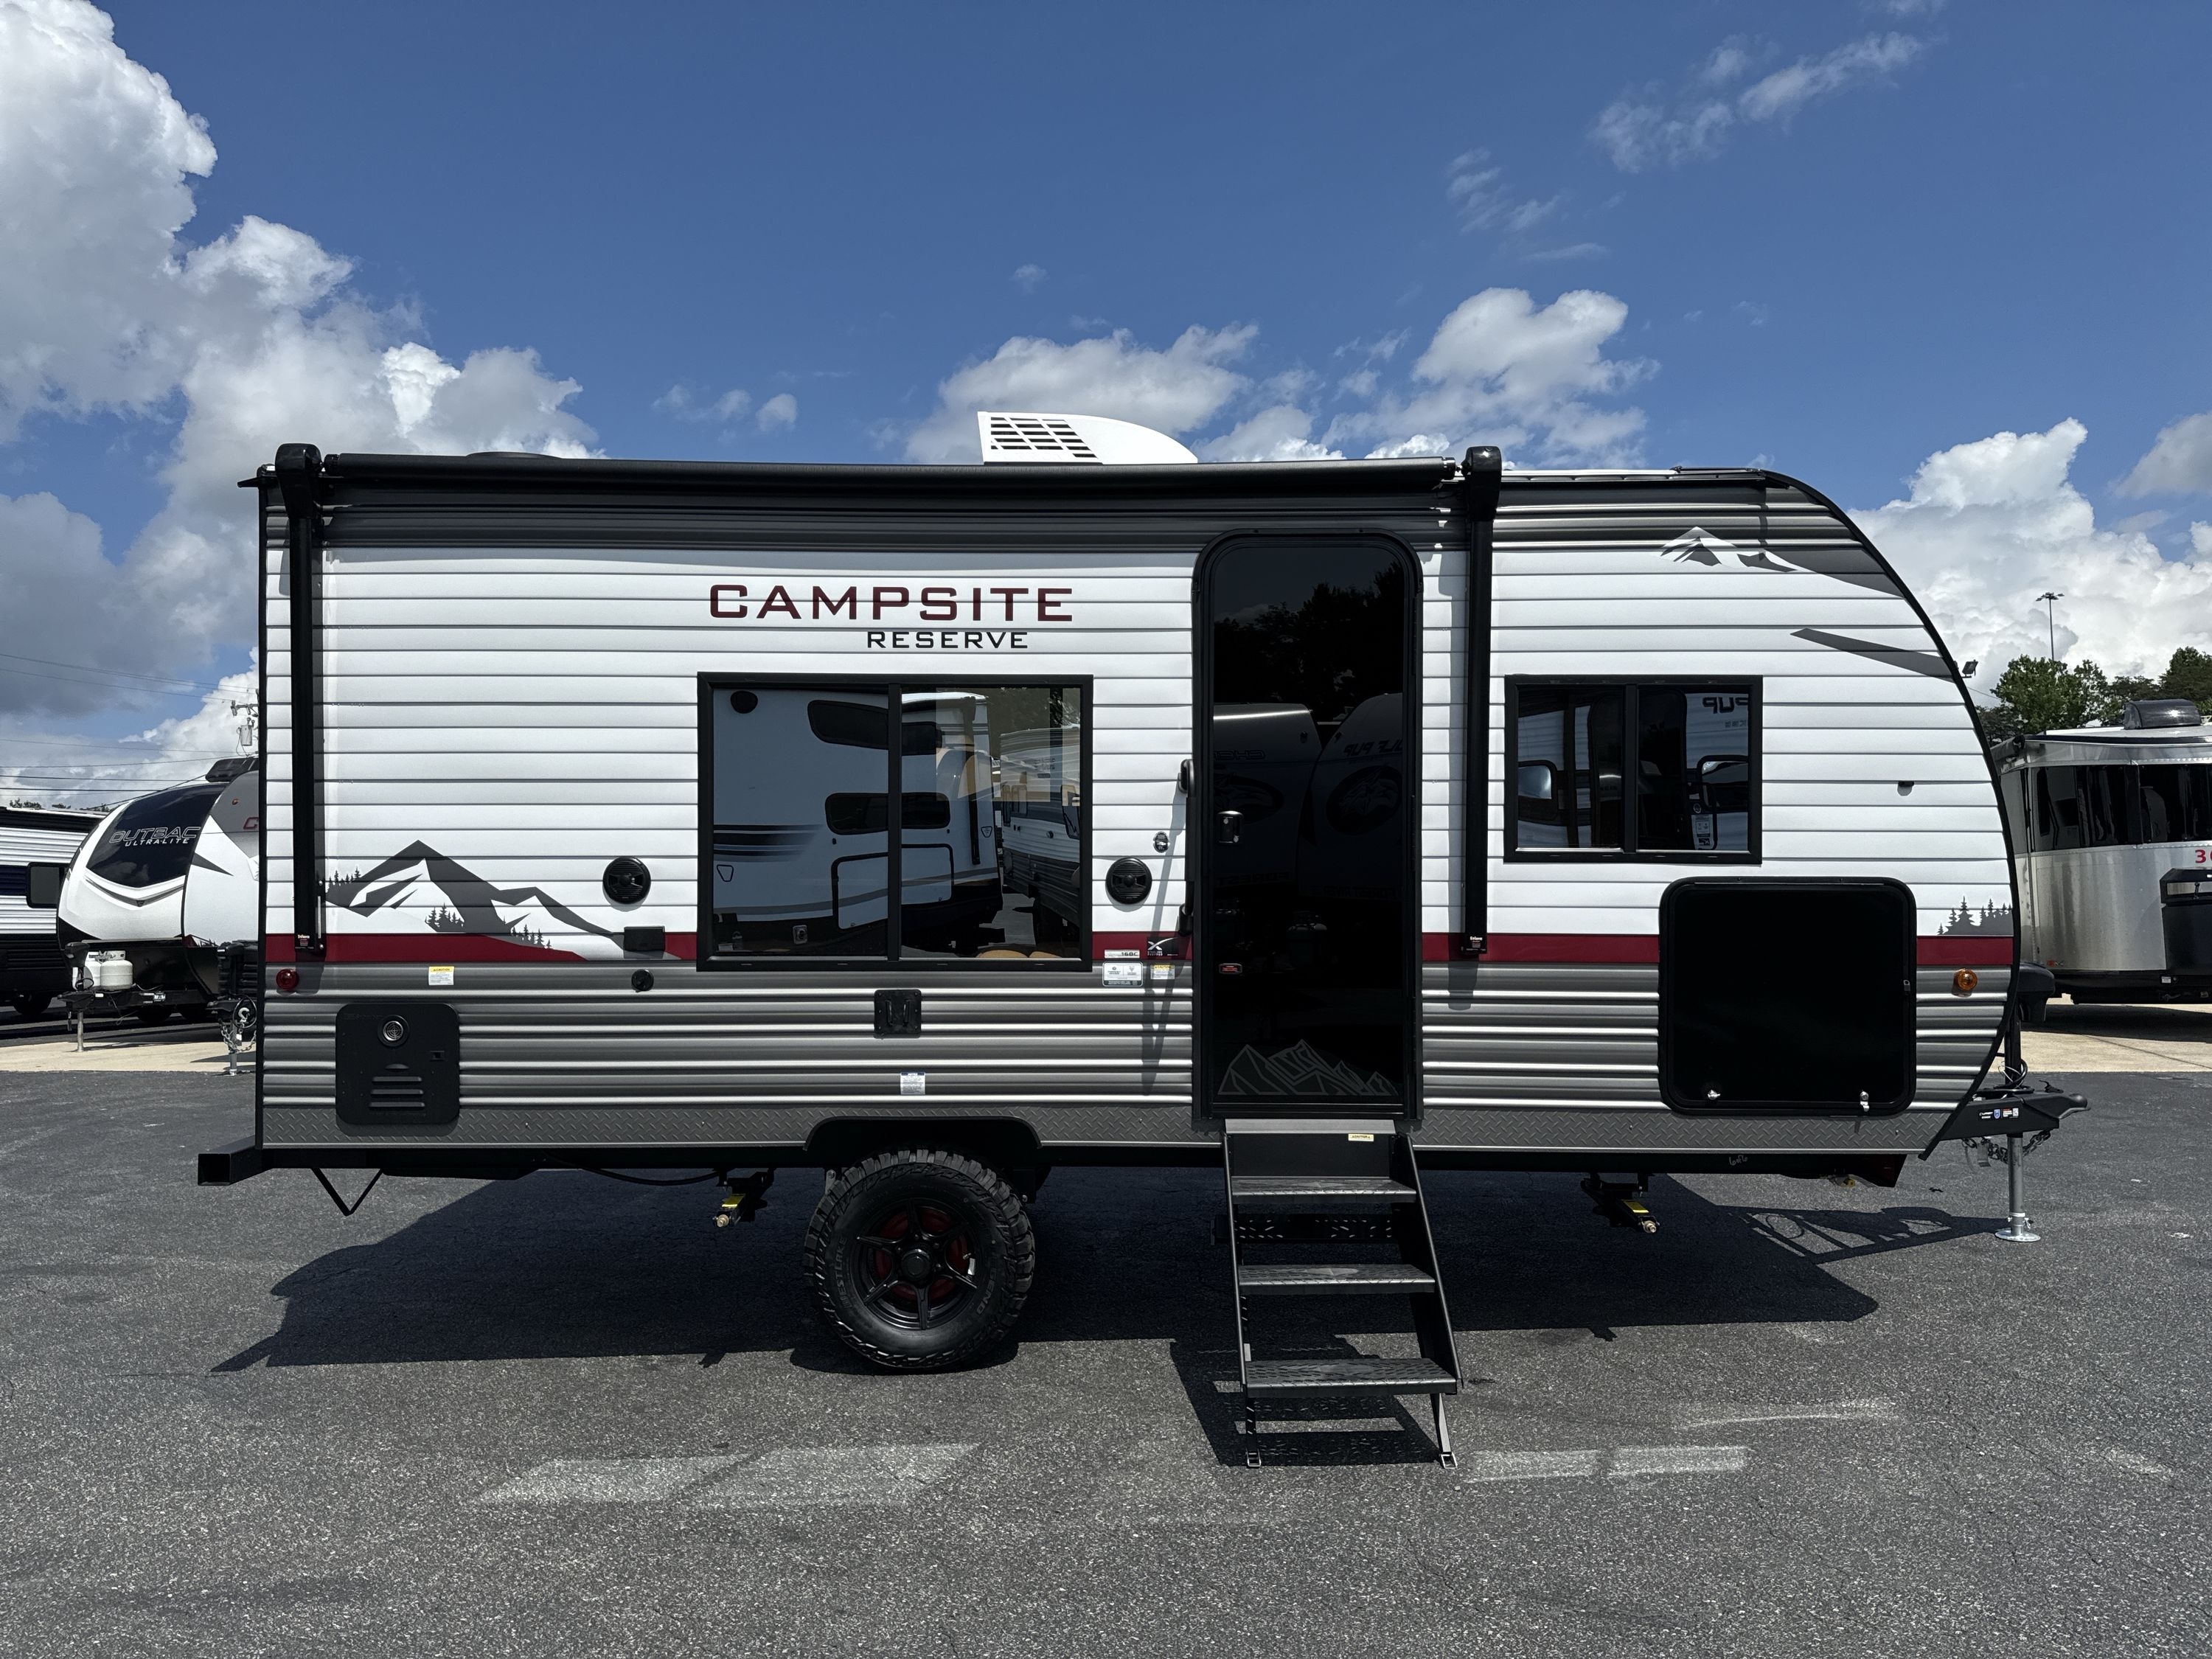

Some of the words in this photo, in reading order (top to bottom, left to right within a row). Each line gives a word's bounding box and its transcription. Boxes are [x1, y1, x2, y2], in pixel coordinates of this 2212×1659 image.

[710, 584, 1073, 622] CAMPSITE
[867, 631, 1029, 649] RESERVE
[125, 838, 190, 847] ULTRA-LITE
[2195, 849, 2212, 864] 3
